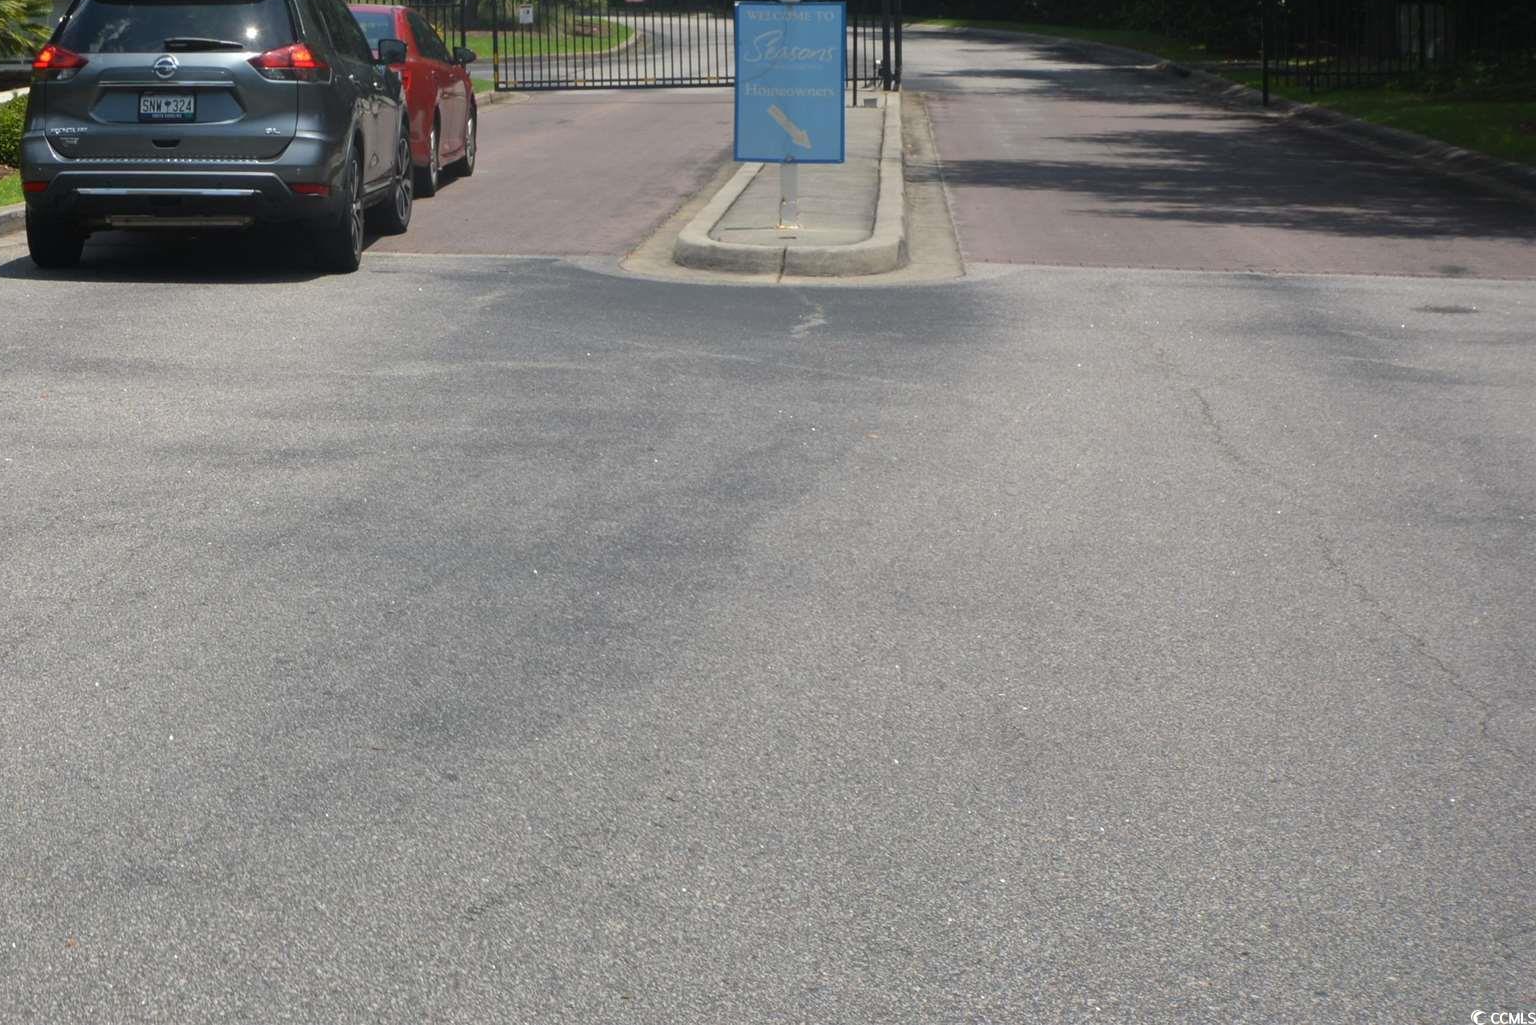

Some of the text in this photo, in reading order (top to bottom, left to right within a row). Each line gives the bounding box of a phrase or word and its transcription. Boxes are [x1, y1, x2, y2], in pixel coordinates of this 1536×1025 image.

[816, 10, 834, 22] TO
[744, 29, 835, 64] Seasons
[744, 81, 835, 97] Homeowners
[172, 99, 192, 112] 324
